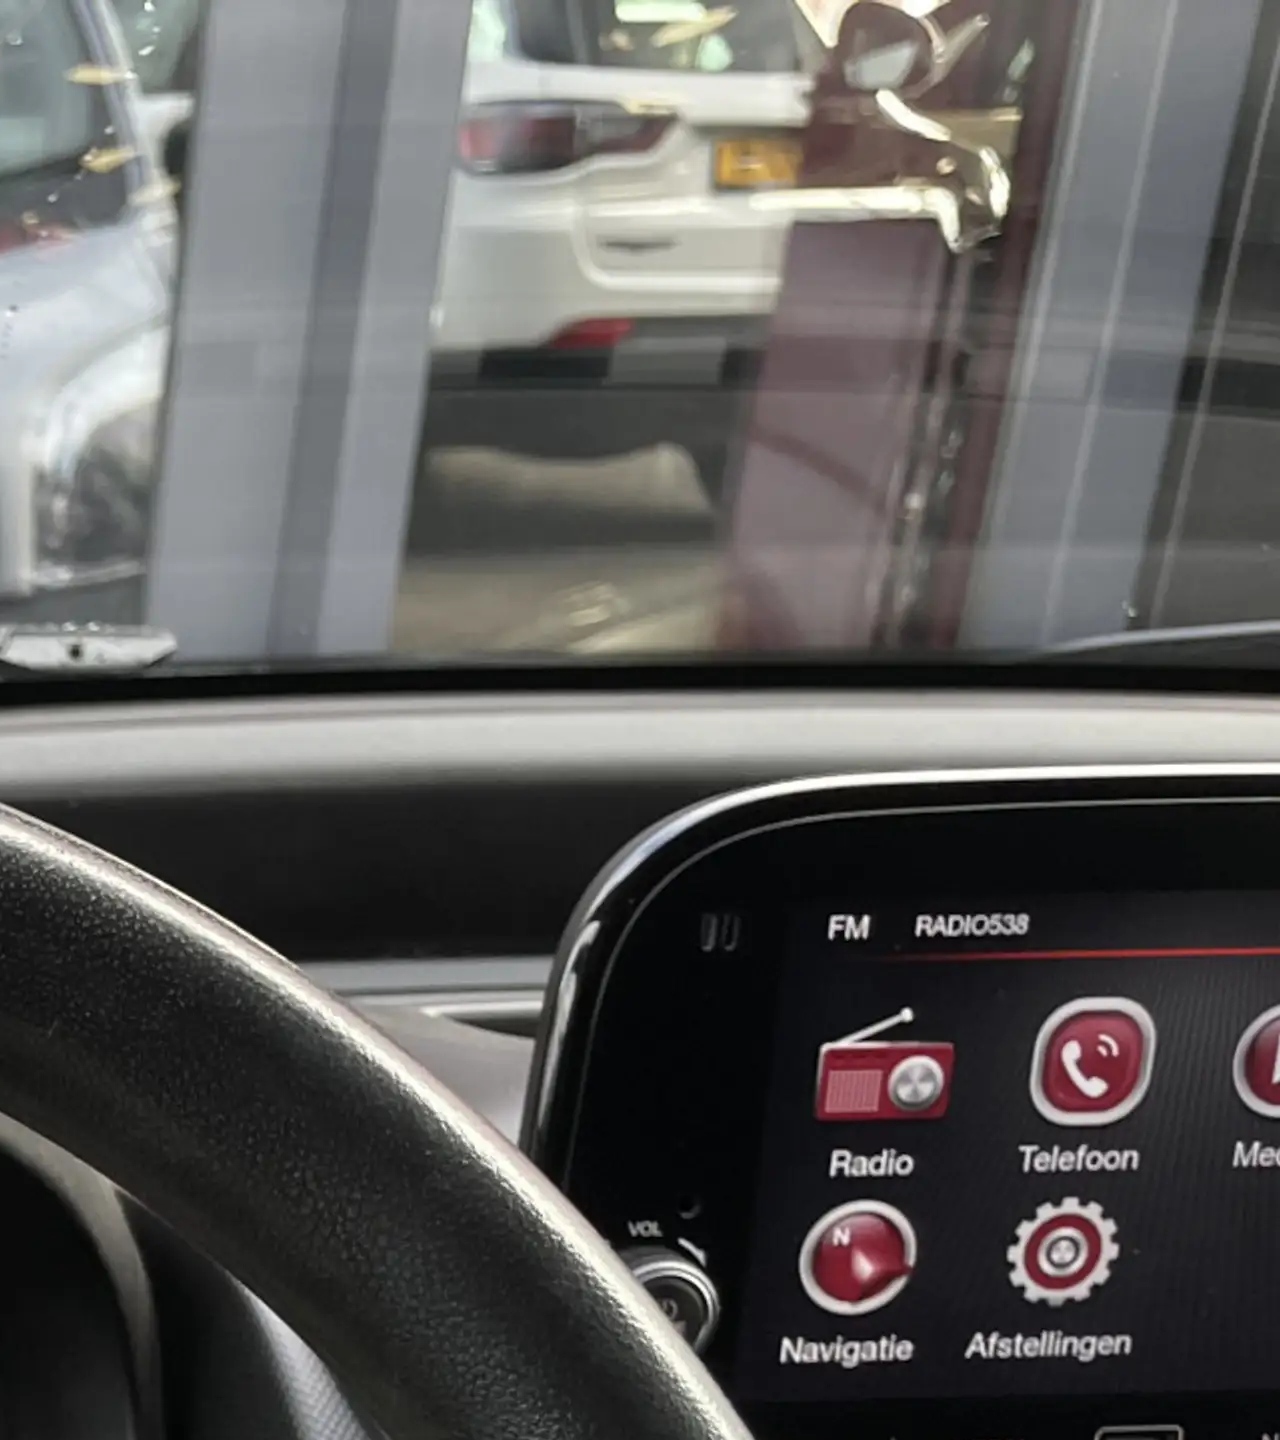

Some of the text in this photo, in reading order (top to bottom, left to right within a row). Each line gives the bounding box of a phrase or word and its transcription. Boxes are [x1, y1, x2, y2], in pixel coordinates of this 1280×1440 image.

[827, 914, 1030, 941] FM RADIO538
[829, 1150, 914, 1178] Radio
[1018, 1144, 1140, 1174] Telefoon
[627, 1220, 663, 1238] VOL
[779, 1334, 915, 1368] Navigatie
[964, 1330, 1132, 1363] Afstellingen
